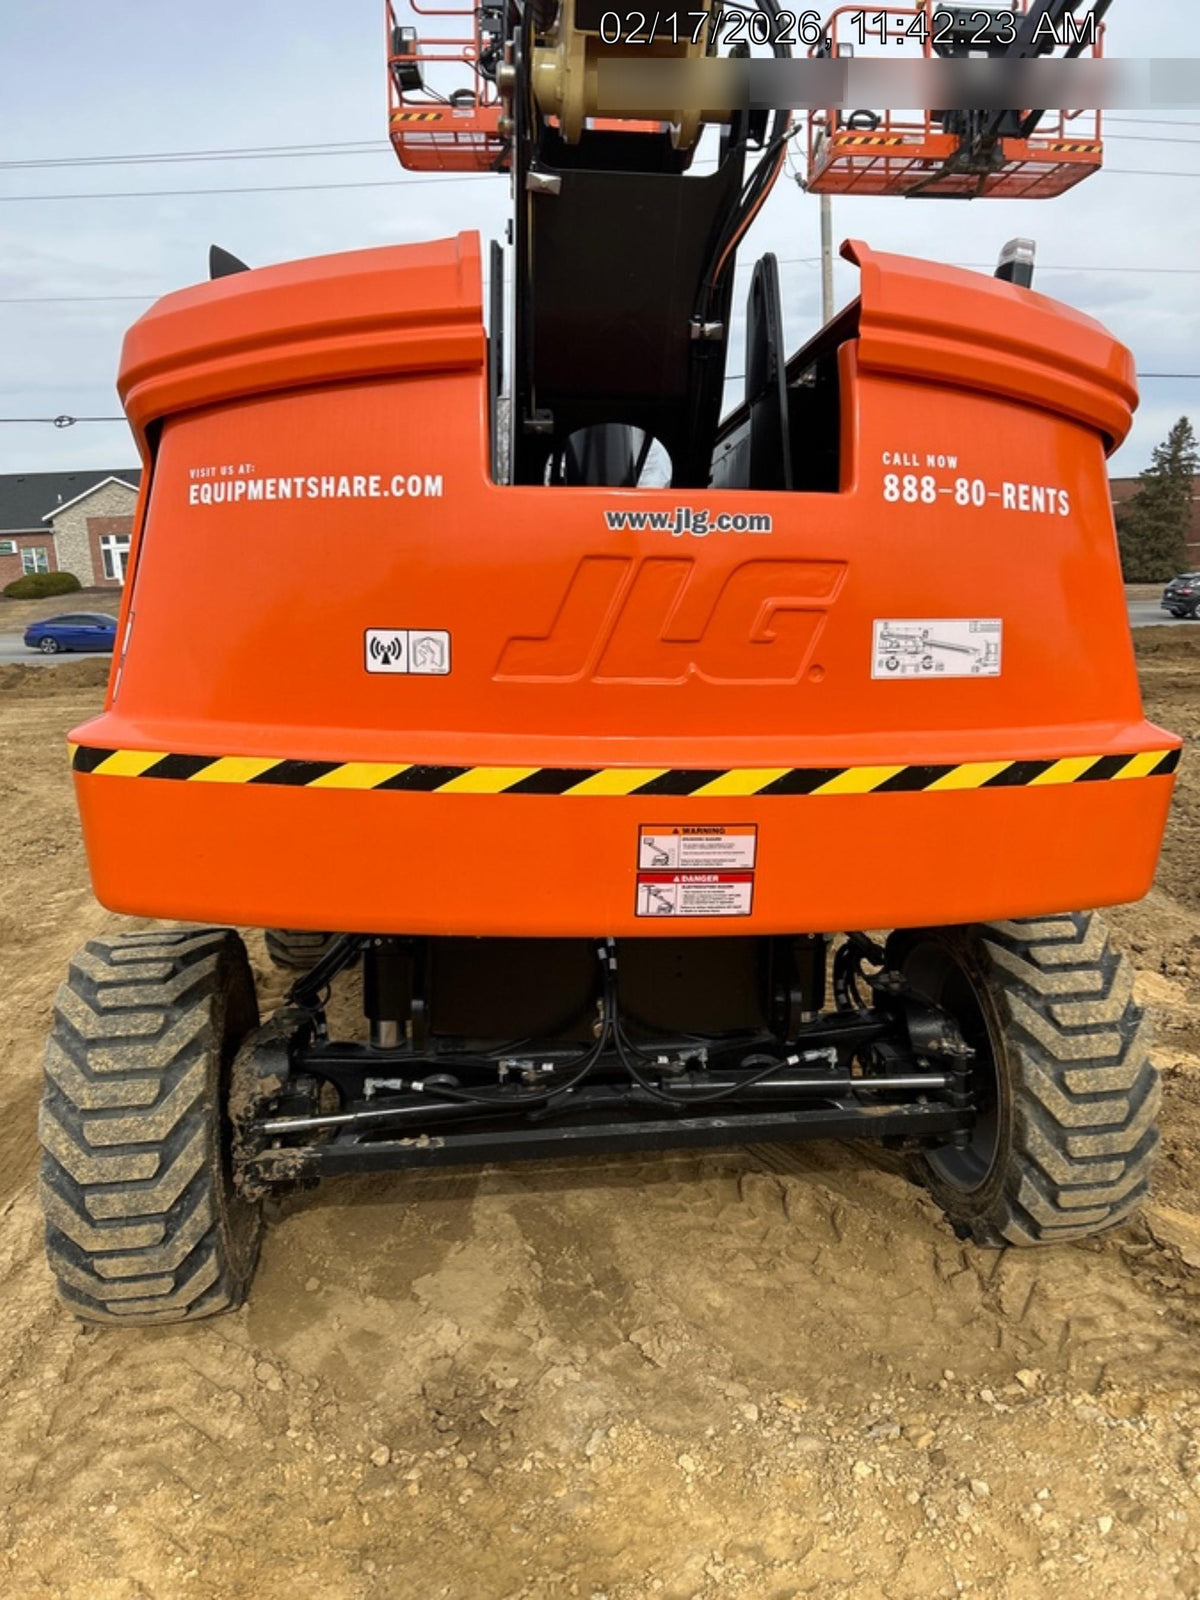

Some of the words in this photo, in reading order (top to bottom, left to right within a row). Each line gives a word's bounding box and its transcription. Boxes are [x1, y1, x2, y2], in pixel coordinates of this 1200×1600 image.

[189, 466, 216, 479] VISIT
[220, 465, 234, 476] US
[238, 463, 255, 474] AT:
[882, 451, 920, 467] CALL
[926, 454, 958, 469] NOW
[189, 474, 443, 505] EQUIPMENTSHARE.COM
[883, 473, 1070, 516] 888-80-RENTS
[605, 508, 772, 537] www.jlg.com
[492, 554, 849, 685] JLG
[682, 827, 726, 835] WARNING
[681, 874, 719, 883] DANGER
